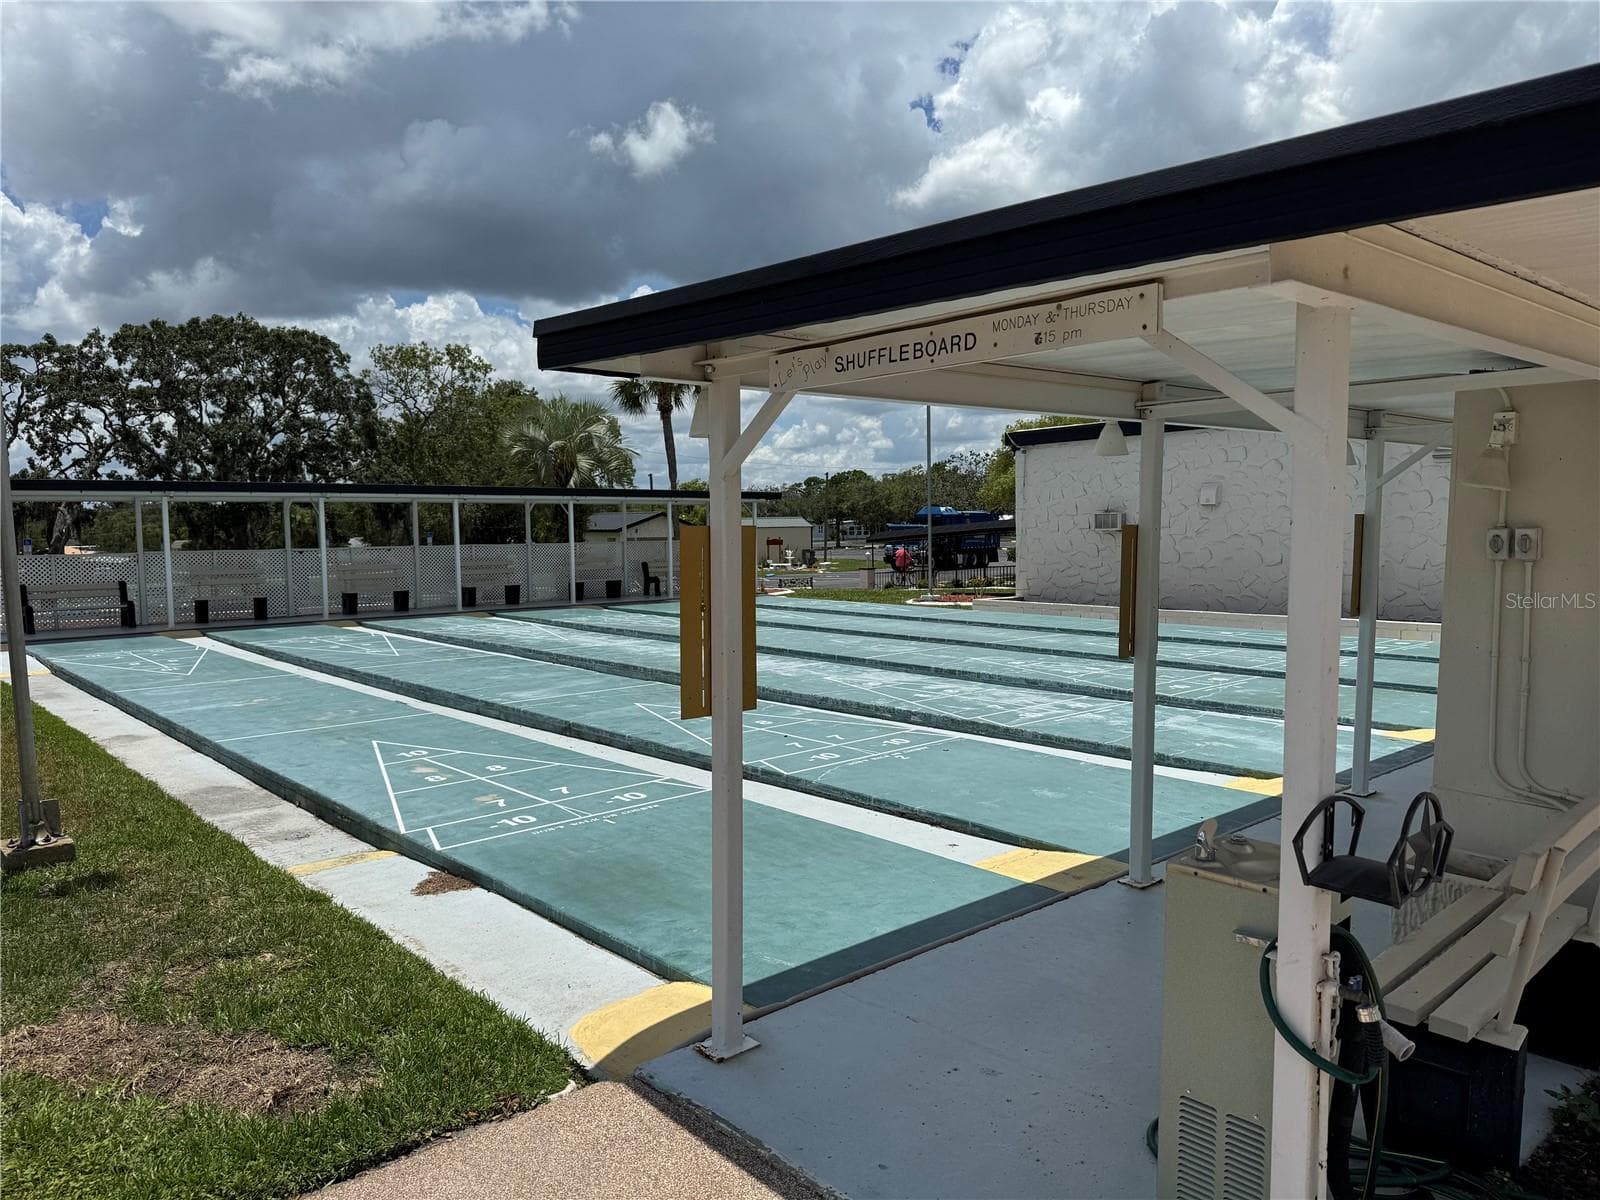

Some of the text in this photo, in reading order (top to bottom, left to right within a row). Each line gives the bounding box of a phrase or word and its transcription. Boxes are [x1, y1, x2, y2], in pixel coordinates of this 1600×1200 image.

[992, 296, 1134, 333] MONDAY & THURSDAY
[834, 332, 977, 373] SHUFFLEBOARD
[1062, 328, 1082, 344] pm
